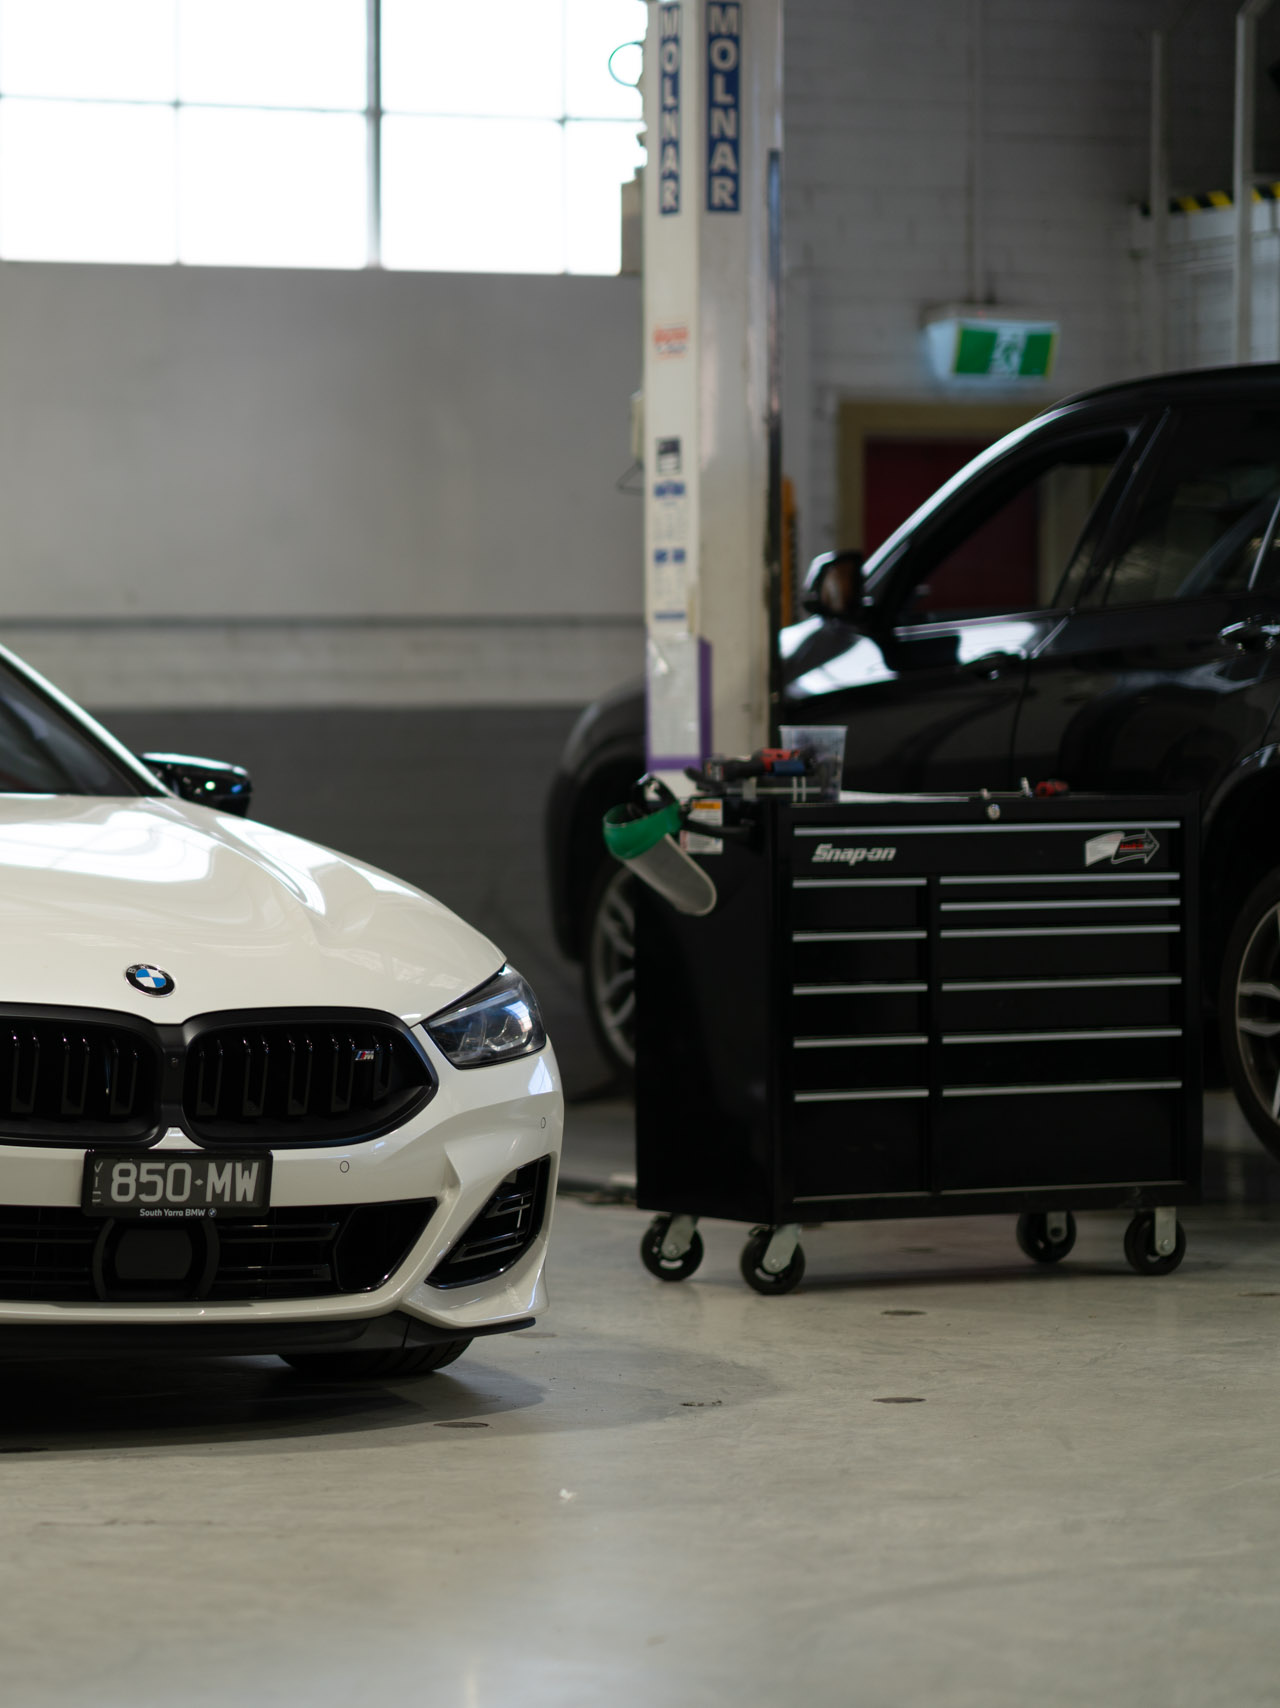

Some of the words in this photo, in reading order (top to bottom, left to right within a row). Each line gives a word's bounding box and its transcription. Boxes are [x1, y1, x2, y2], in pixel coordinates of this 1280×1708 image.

[662, 7, 679, 210] MOLNAR
[709, 6, 738, 208] MOLNAR
[811, 843, 897, 866] Snap-on
[139, 1208, 162, 1217] South
[163, 1208, 184, 1217] Yarra
[185, 1208, 206, 1217] BMW
